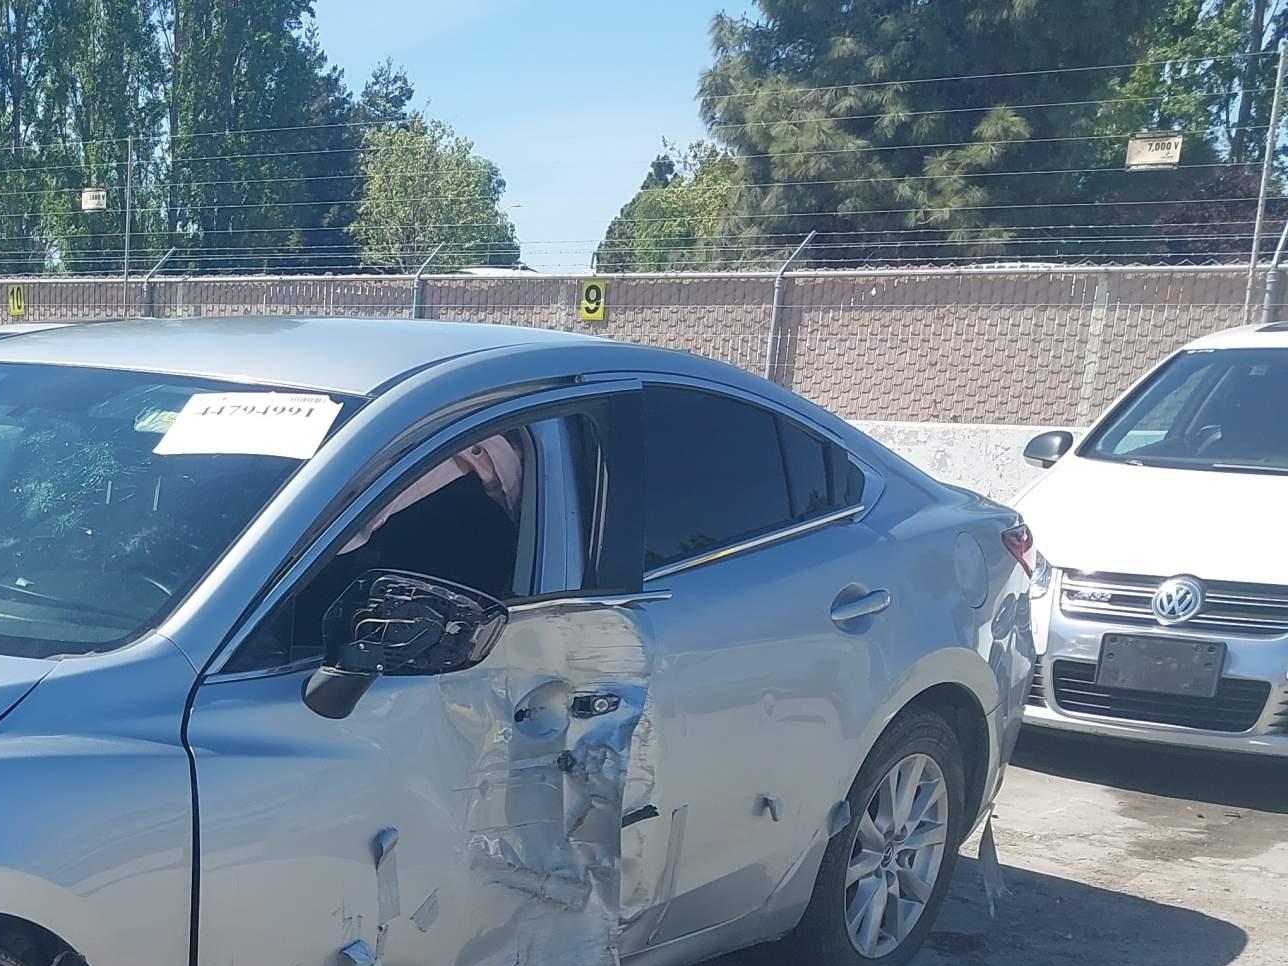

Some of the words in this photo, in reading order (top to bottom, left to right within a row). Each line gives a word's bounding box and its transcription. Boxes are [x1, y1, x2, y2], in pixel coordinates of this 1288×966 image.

[1147, 141, 1172, 152] 7,000
[1174, 141, 1180, 151] V
[10, 286, 22, 311] 10
[584, 284, 602, 314] 9
